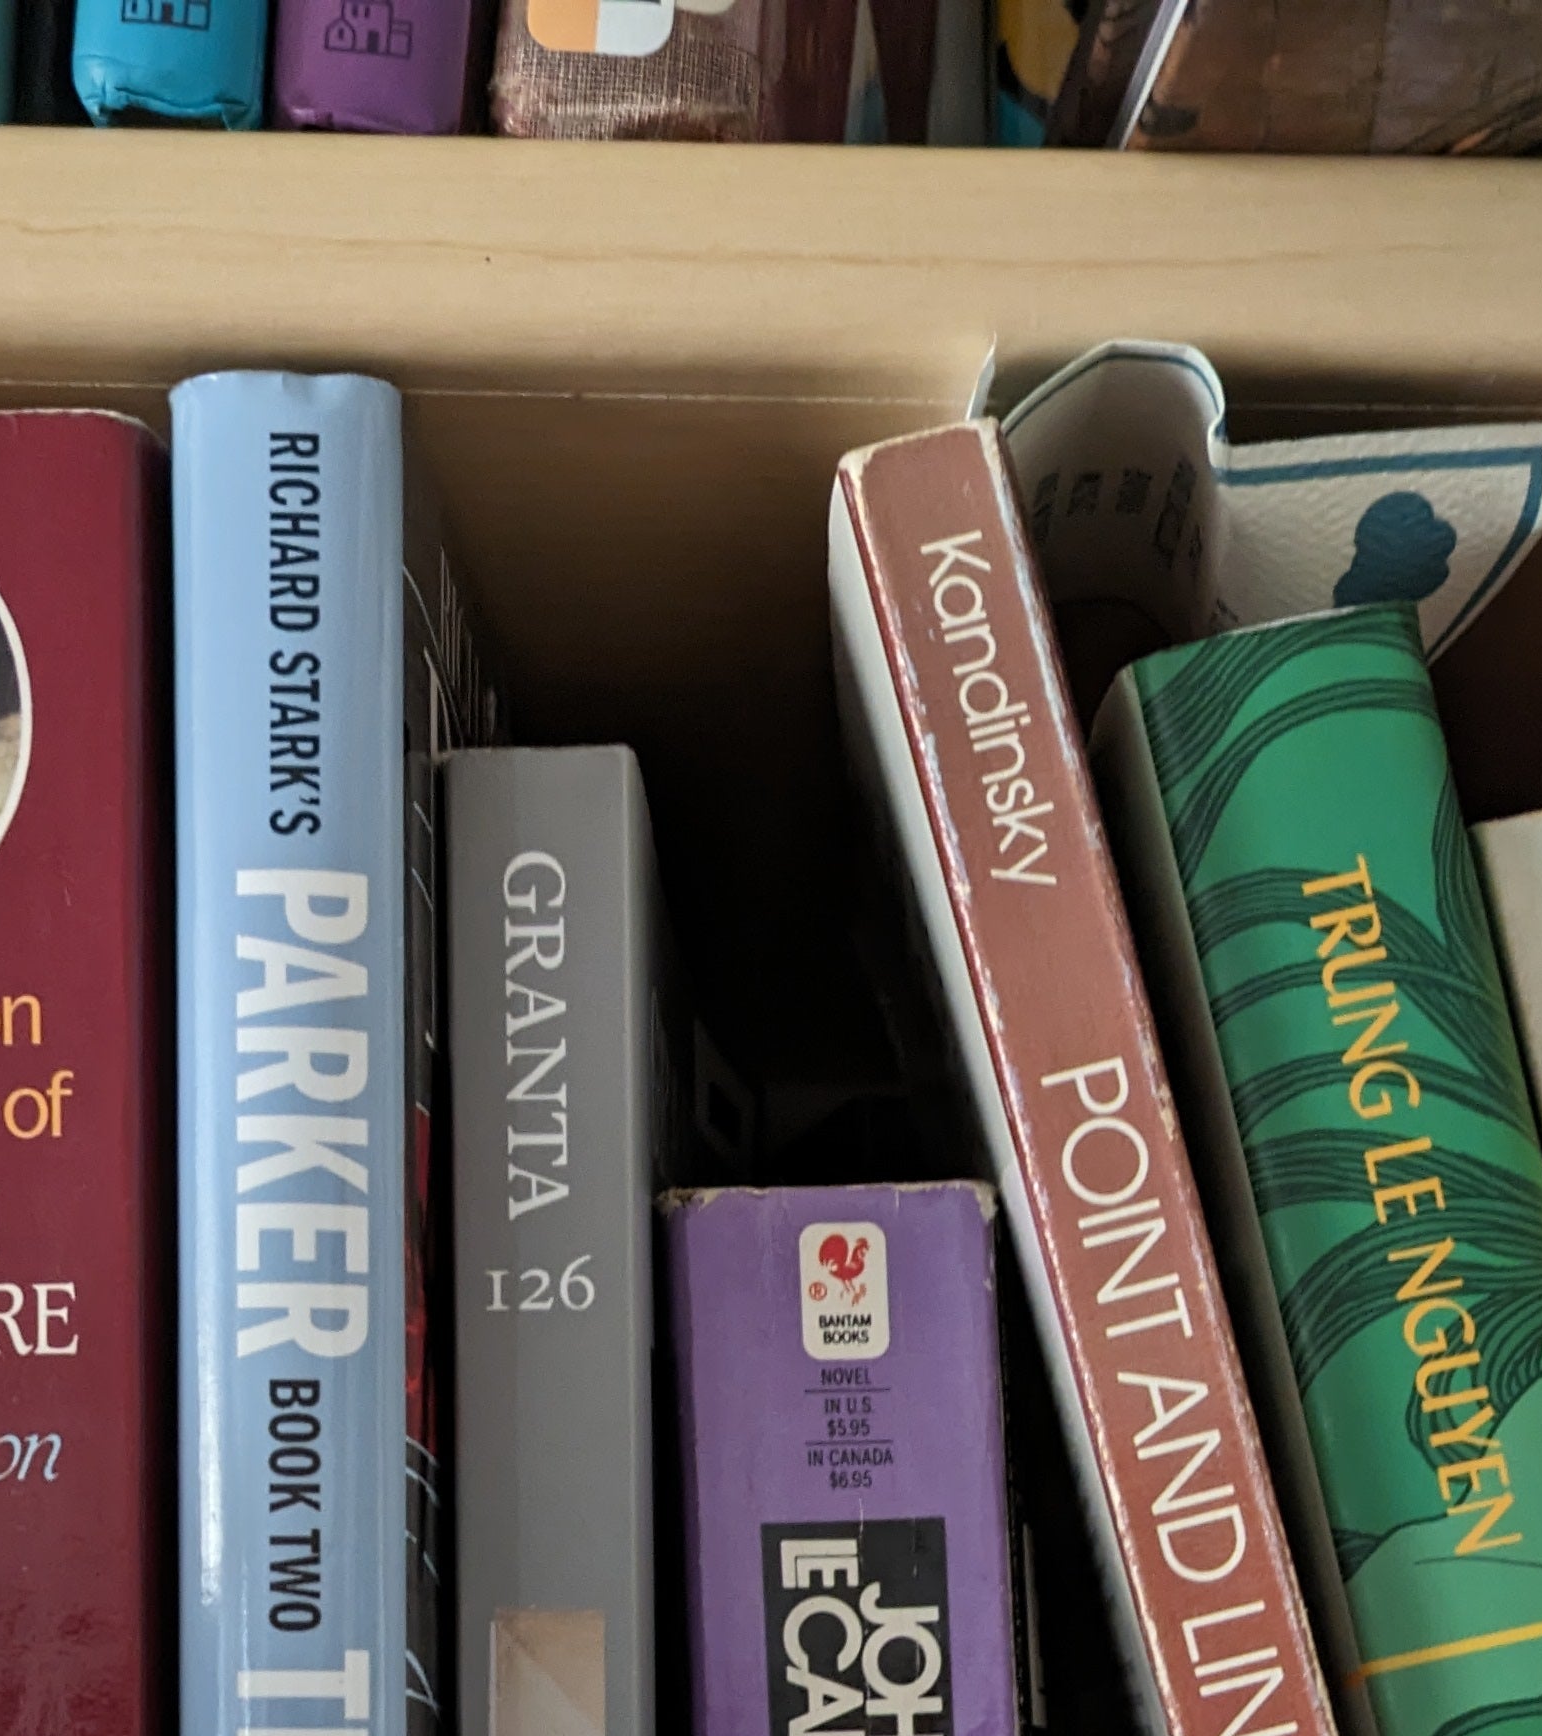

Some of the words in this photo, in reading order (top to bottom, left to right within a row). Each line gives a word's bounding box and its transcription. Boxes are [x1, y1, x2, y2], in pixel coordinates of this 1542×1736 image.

[267, 430, 321, 635] RICHARD
[267, 651, 323, 837] STARK'S
[1301, 852, 1421, 1119] TRUNG
[502, 850, 570, 1222] GRANTA
[920, 528, 1058, 888] Kandinsky
[1041, 1056, 1193, 1338] POINT
[1117, 1371, 1247, 1583] AND
[4, 1070, 74, 1138] of
[235, 868, 371, 1360] PARKER
[1364, 1136, 1446, 1225] LE
[485, 1254, 597, 1312] 126
[819, 1313, 872, 1329] BANTAM
[820, 1367, 872, 1386] NOVEL
[823, 1330, 870, 1345] BOOKS
[824, 1397, 841, 1414] IN
[827, 1418, 871, 1438] $5.95
[1387, 1237, 1524, 1557] NGUYEN
[267, 1378, 322, 1515] BOOK
[807, 1449, 824, 1467] IN
[828, 1447, 894, 1467] CANADA
[267, 1527, 323, 1633] TWO
[780, 1538, 860, 1590] LE
